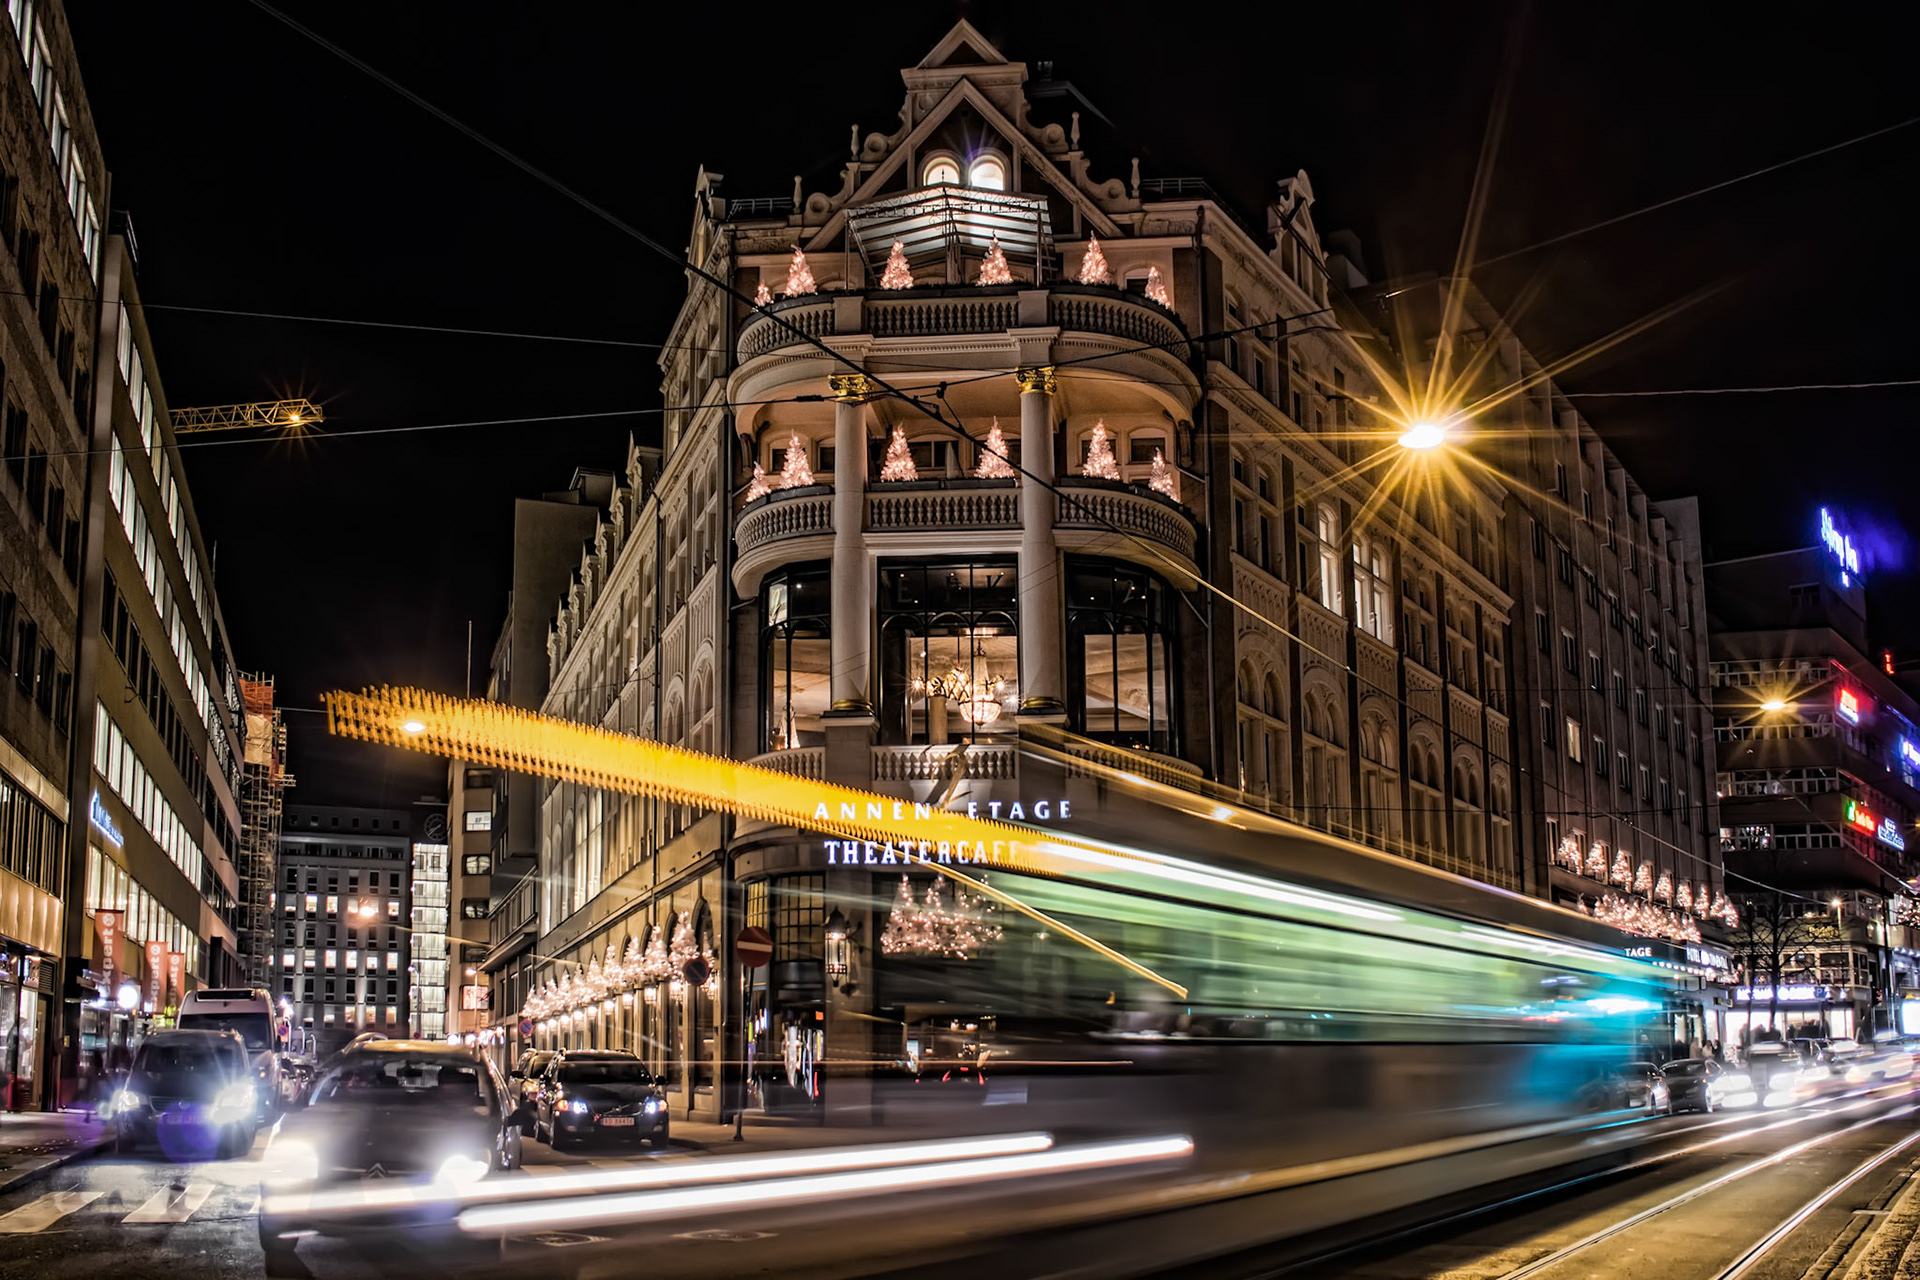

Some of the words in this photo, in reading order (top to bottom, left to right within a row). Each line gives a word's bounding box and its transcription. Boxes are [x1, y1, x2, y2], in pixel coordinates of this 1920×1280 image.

[814, 802, 931, 820] ANNEN
[967, 801, 1072, 819] ETAGE
[151, 957, 160, 1004] xpert
[1816, 988, 1823, 996] P
